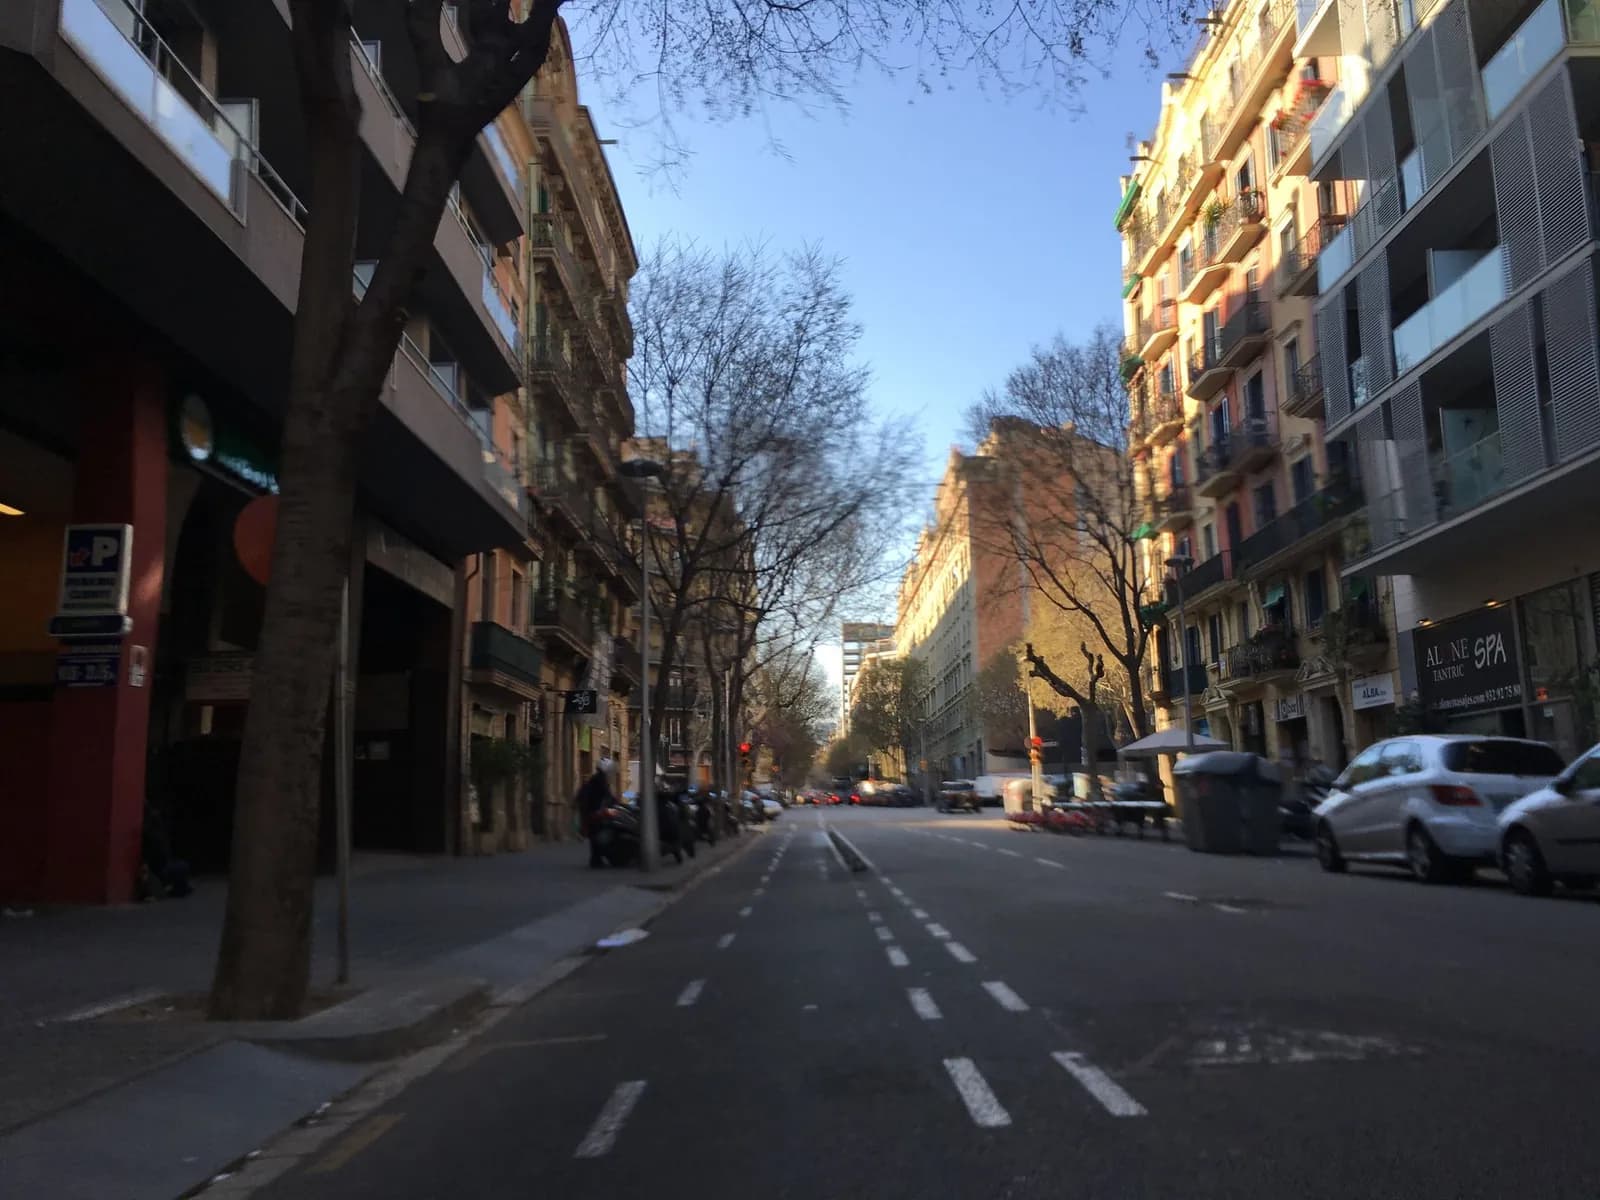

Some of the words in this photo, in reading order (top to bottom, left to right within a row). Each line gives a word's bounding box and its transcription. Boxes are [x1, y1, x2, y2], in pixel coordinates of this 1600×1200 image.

[90, 536, 119, 566] P
[1474, 632, 1506, 669] SPA
[1433, 664, 1464, 682] TANTRIC
